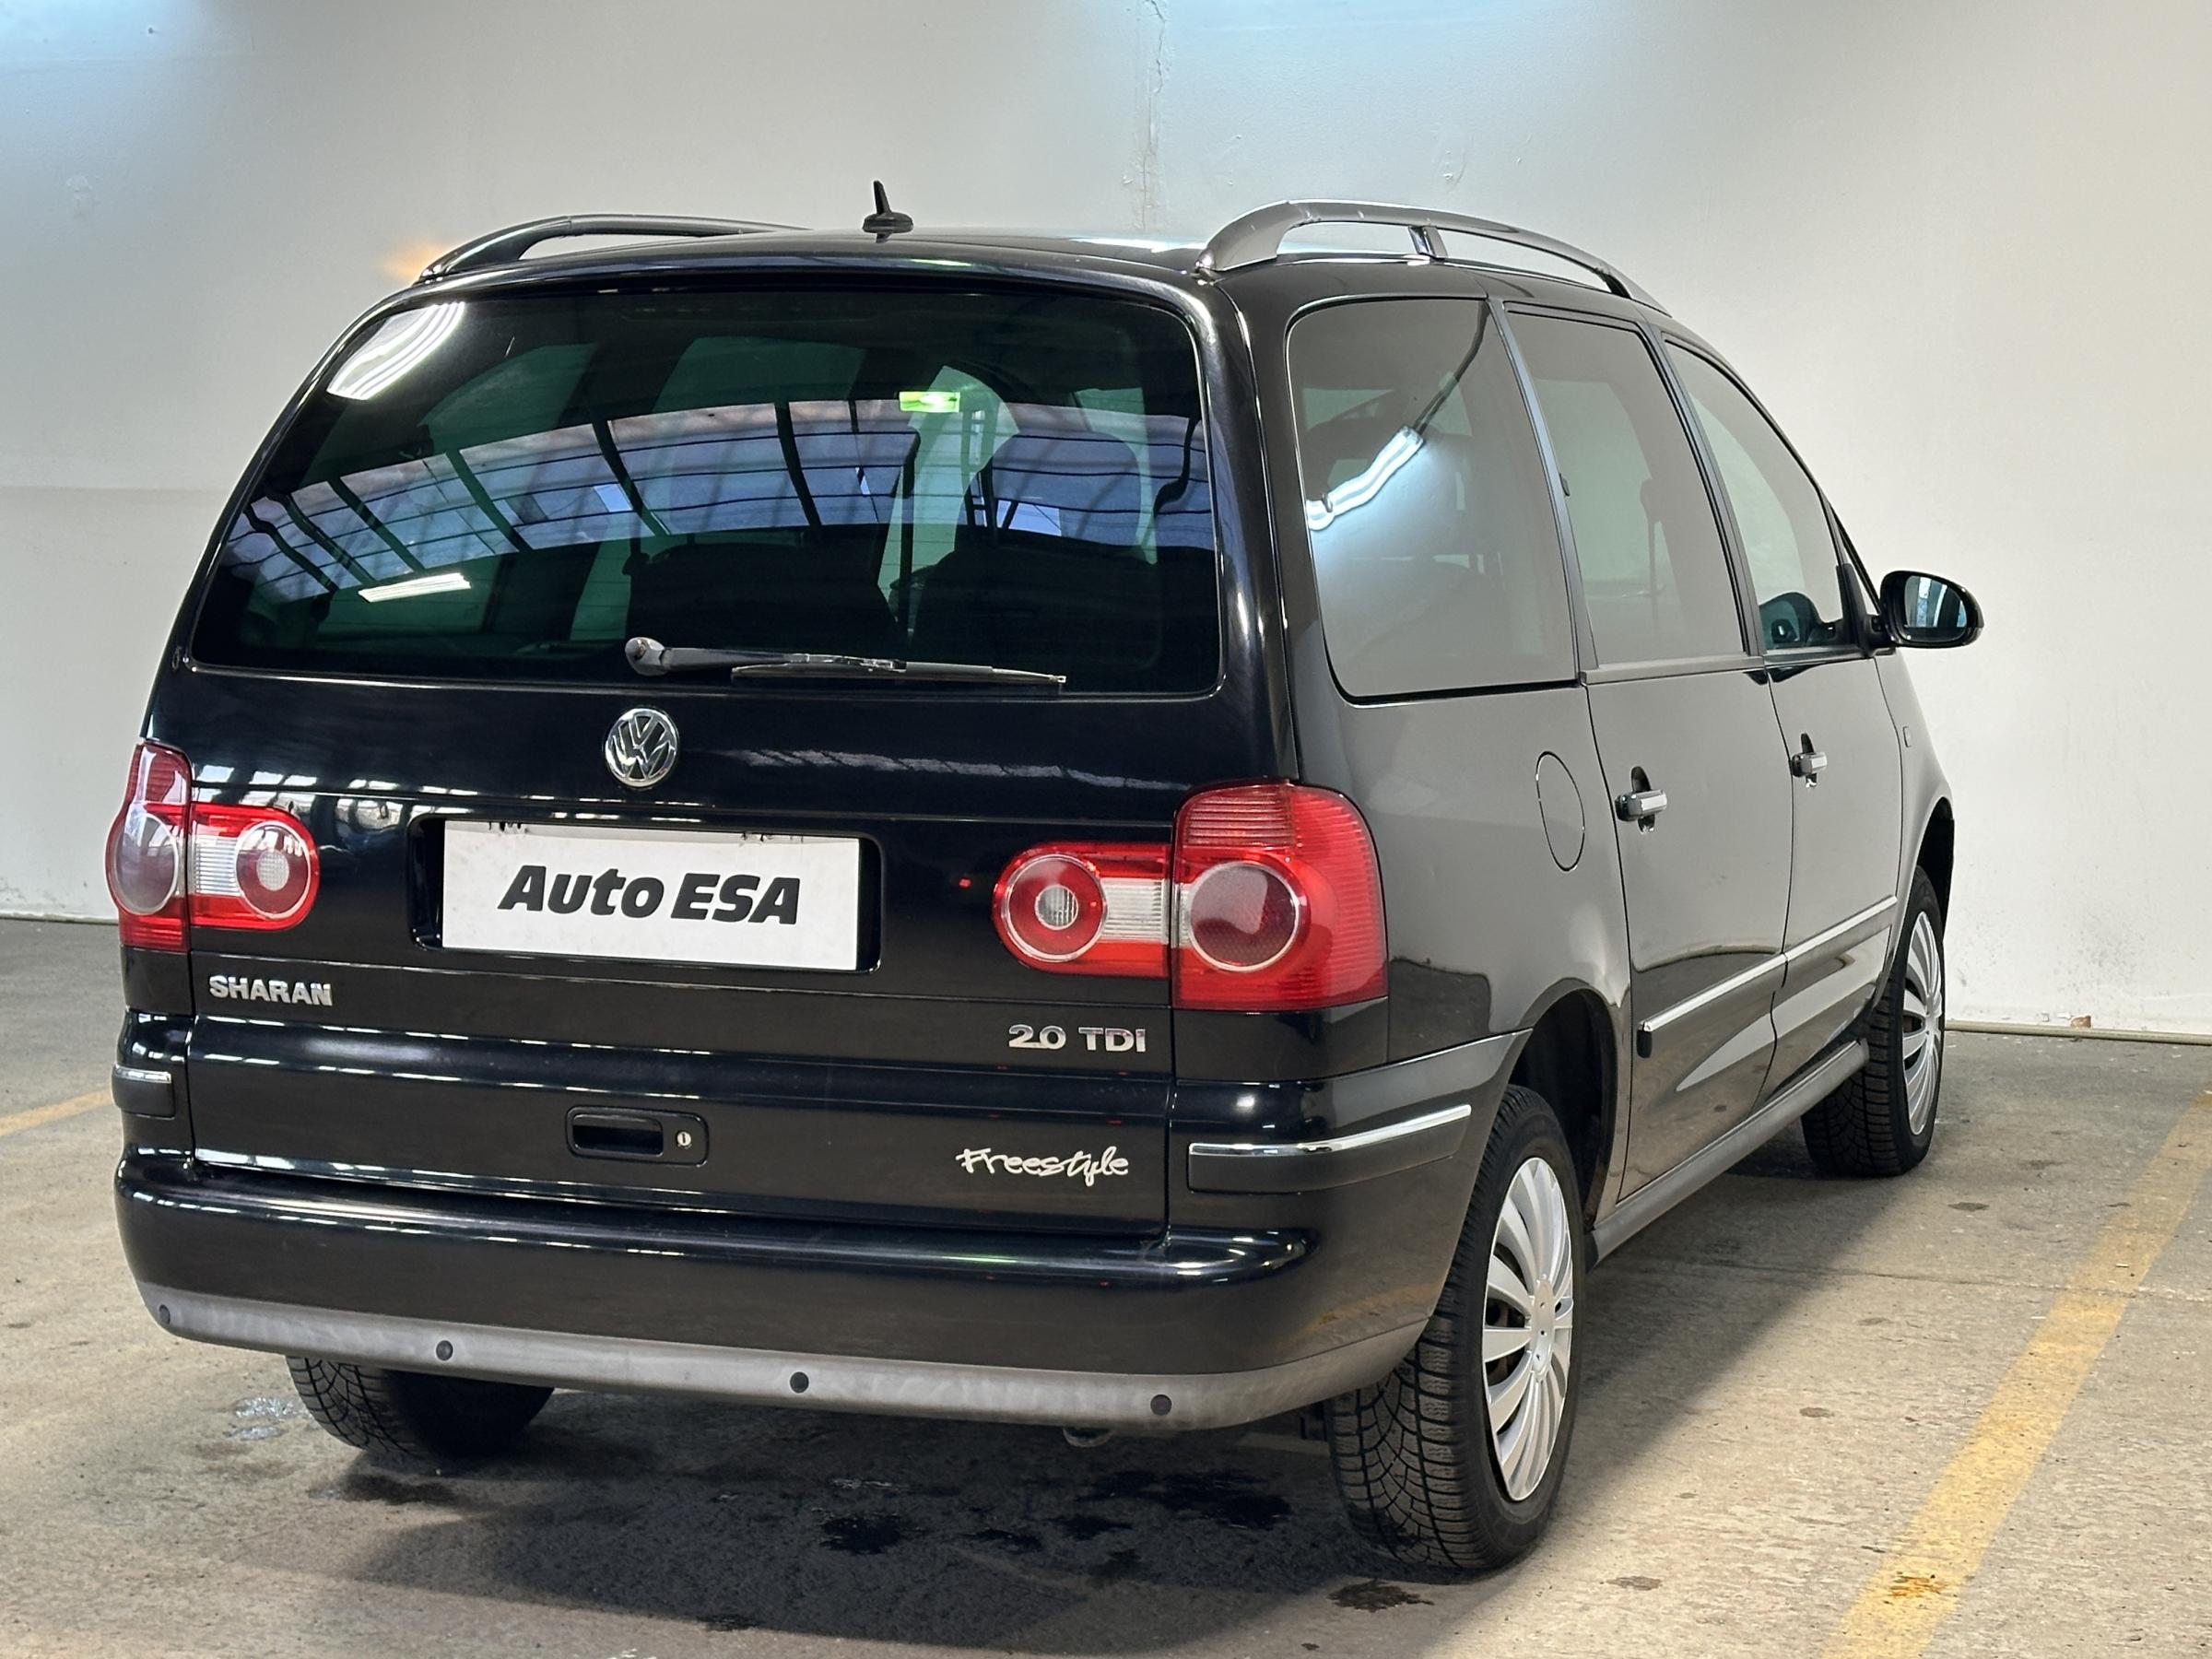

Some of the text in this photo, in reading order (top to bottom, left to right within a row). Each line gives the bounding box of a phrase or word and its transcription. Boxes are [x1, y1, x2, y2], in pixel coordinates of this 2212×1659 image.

[606, 708, 677, 787] VW
[497, 865, 801, 925] Auto ESA
[209, 974, 333, 1006] SHARAN
[1078, 1027, 1147, 1053] TDI
[955, 1146, 1129, 1187] Freestyle
